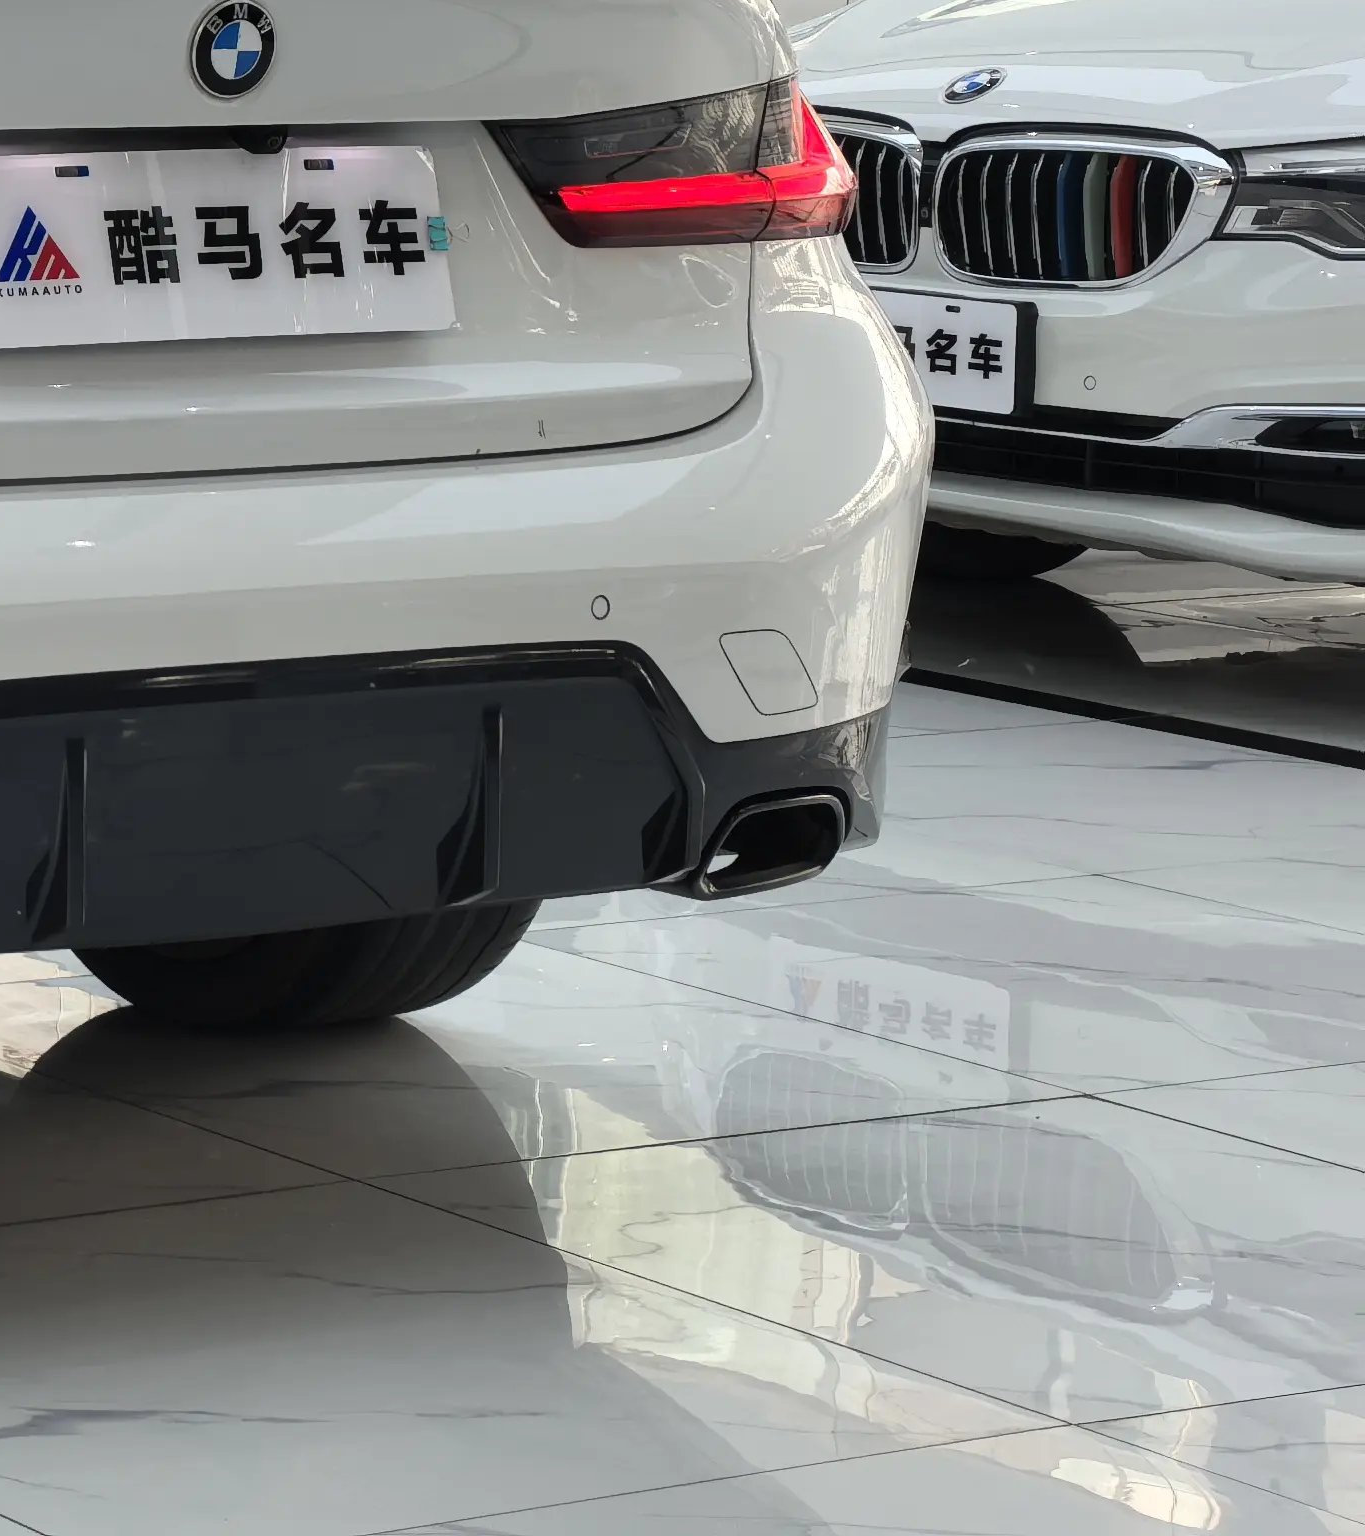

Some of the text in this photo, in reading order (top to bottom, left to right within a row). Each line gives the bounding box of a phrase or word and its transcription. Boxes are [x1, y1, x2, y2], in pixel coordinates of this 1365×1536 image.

[206, 3, 272, 35] BMW
[103, 199, 426, 286] 酷马名车
